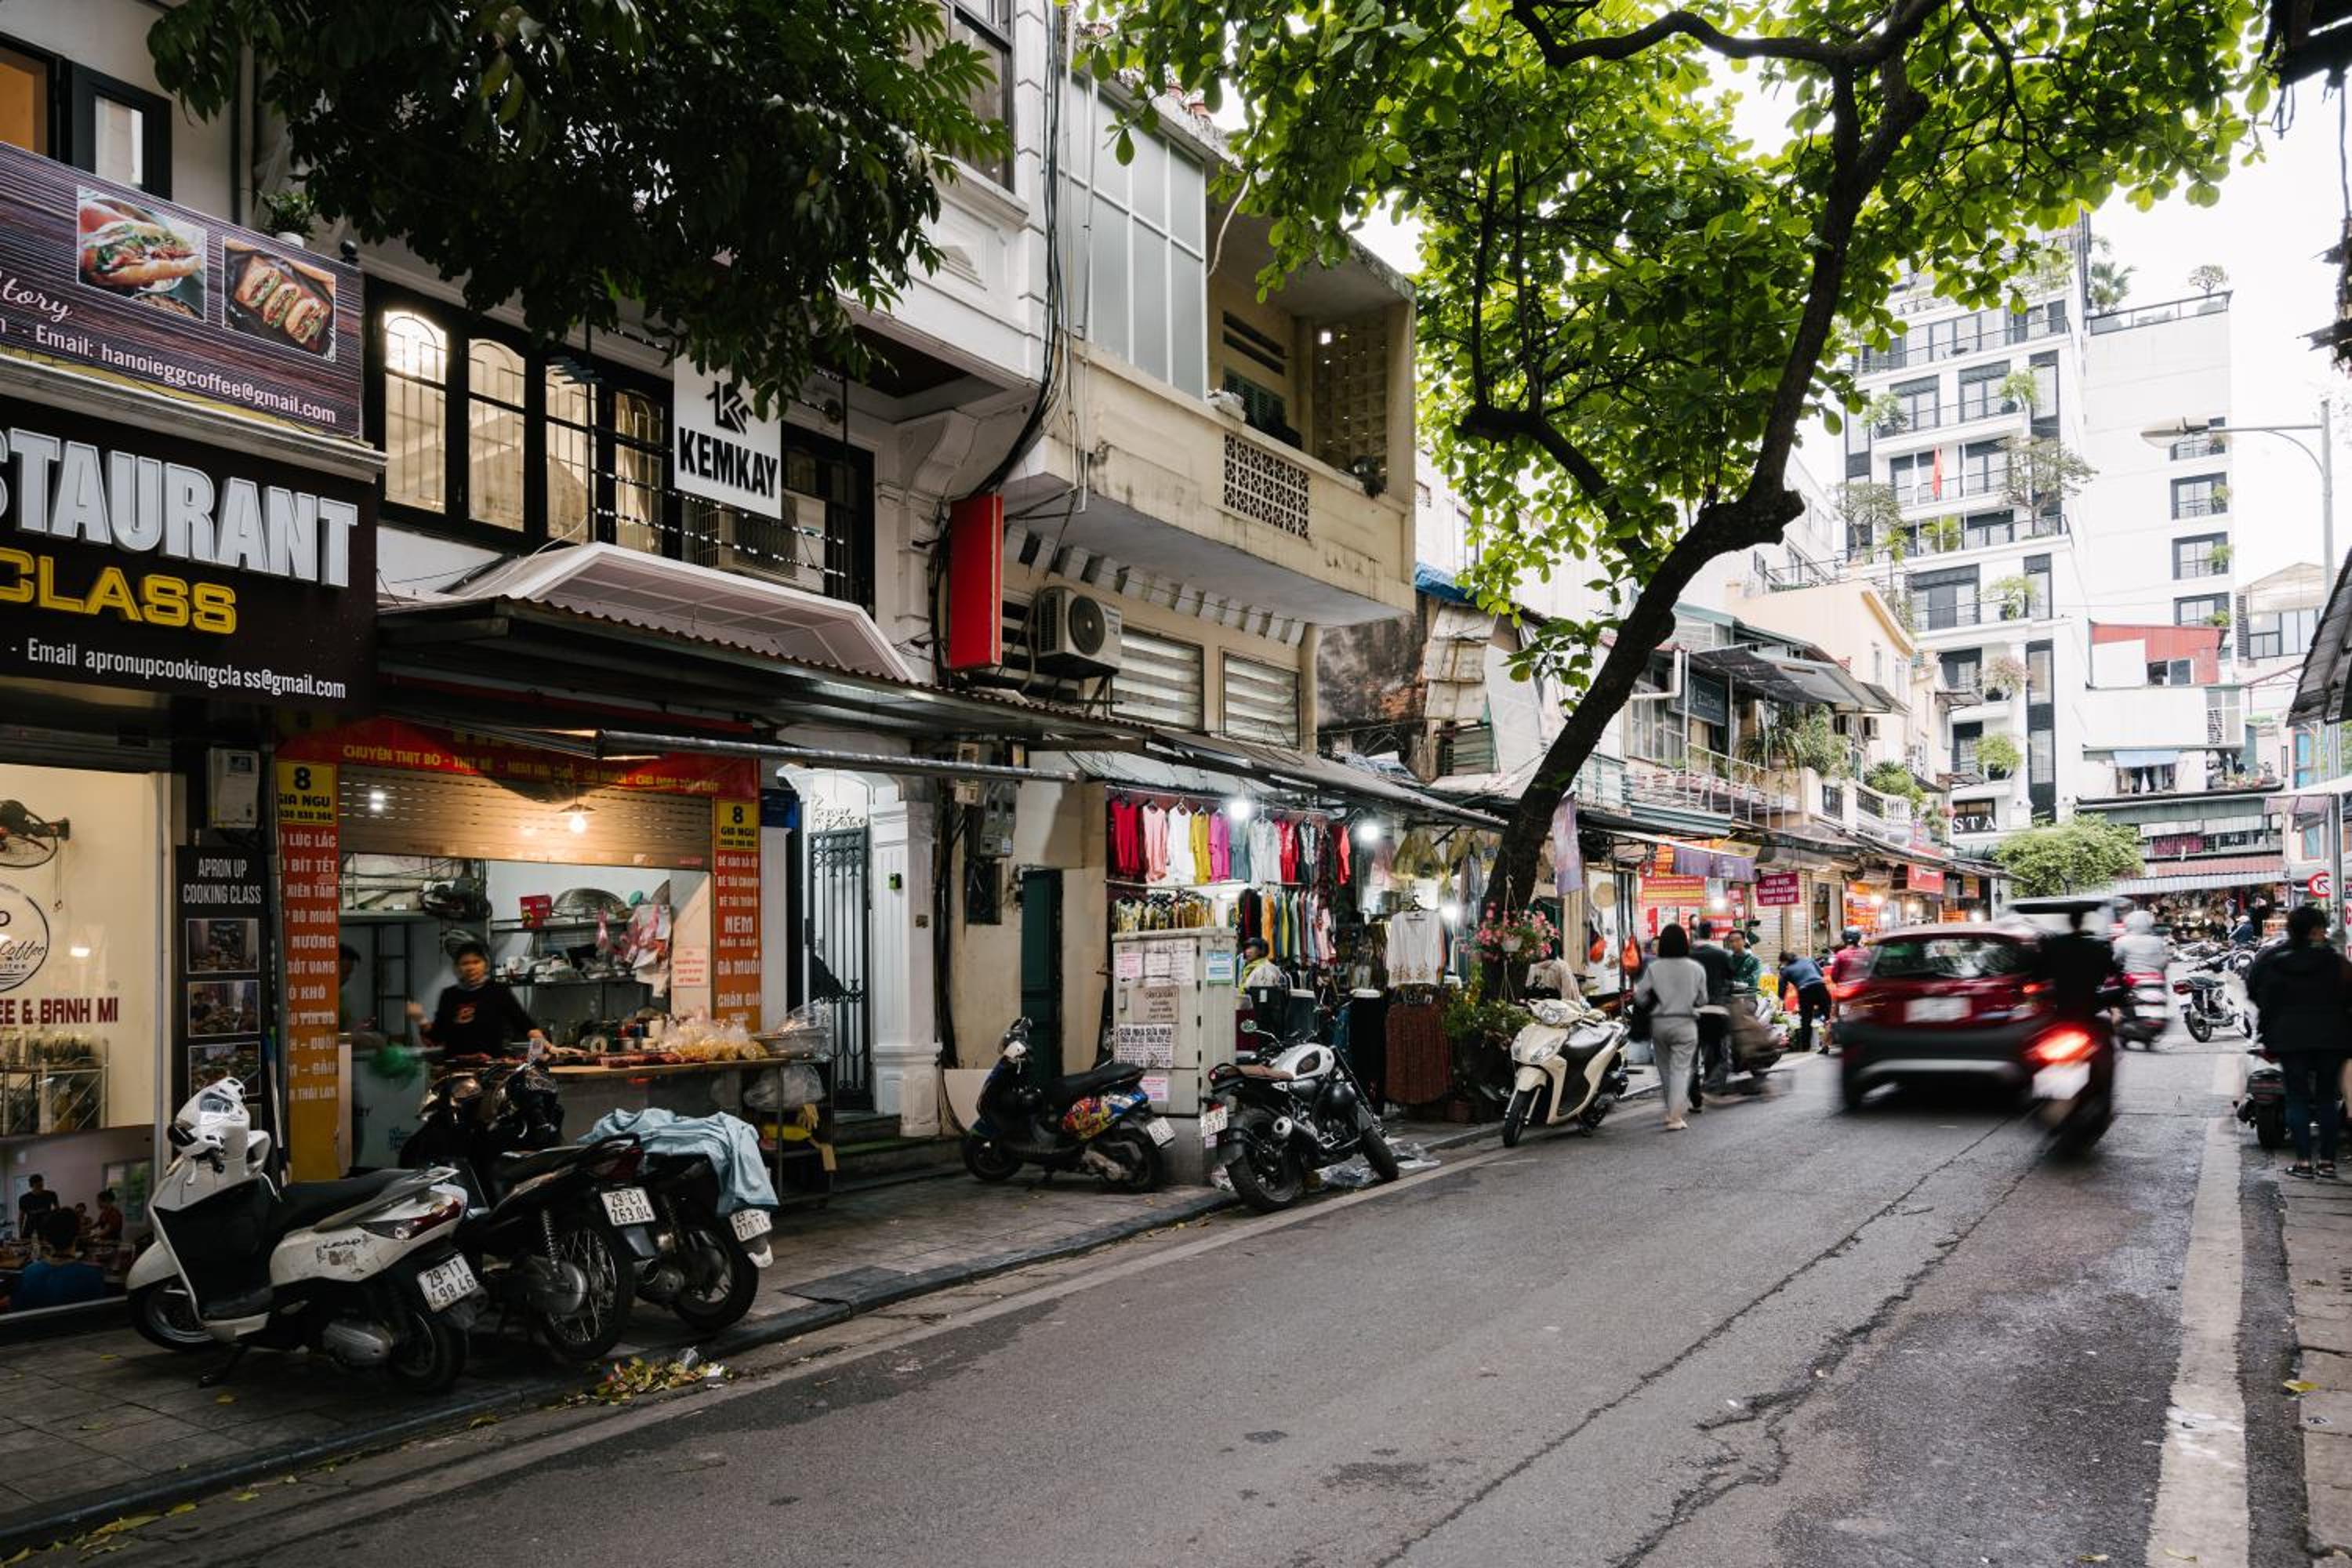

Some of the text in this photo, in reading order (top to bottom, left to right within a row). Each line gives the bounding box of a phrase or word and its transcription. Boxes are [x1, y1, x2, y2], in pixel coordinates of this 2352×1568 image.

[0, 278, 73, 322] tory
[35, 324, 95, 358] Email:
[101, 343, 336, 424] hanoieggcoffee@gmail.com
[678, 426, 778, 499] KEMKAY
[0, 427, 358, 590] TAURANT
[28, 637, 77, 666] Email
[294, 767, 311, 790] 8
[733, 805, 744, 824] 8
[198, 858, 247, 878] APRON UP
[183, 883, 262, 904] COOKING CLASS
[724, 916, 753, 934] NEM
[426, 1273, 474, 1305] 498.46
